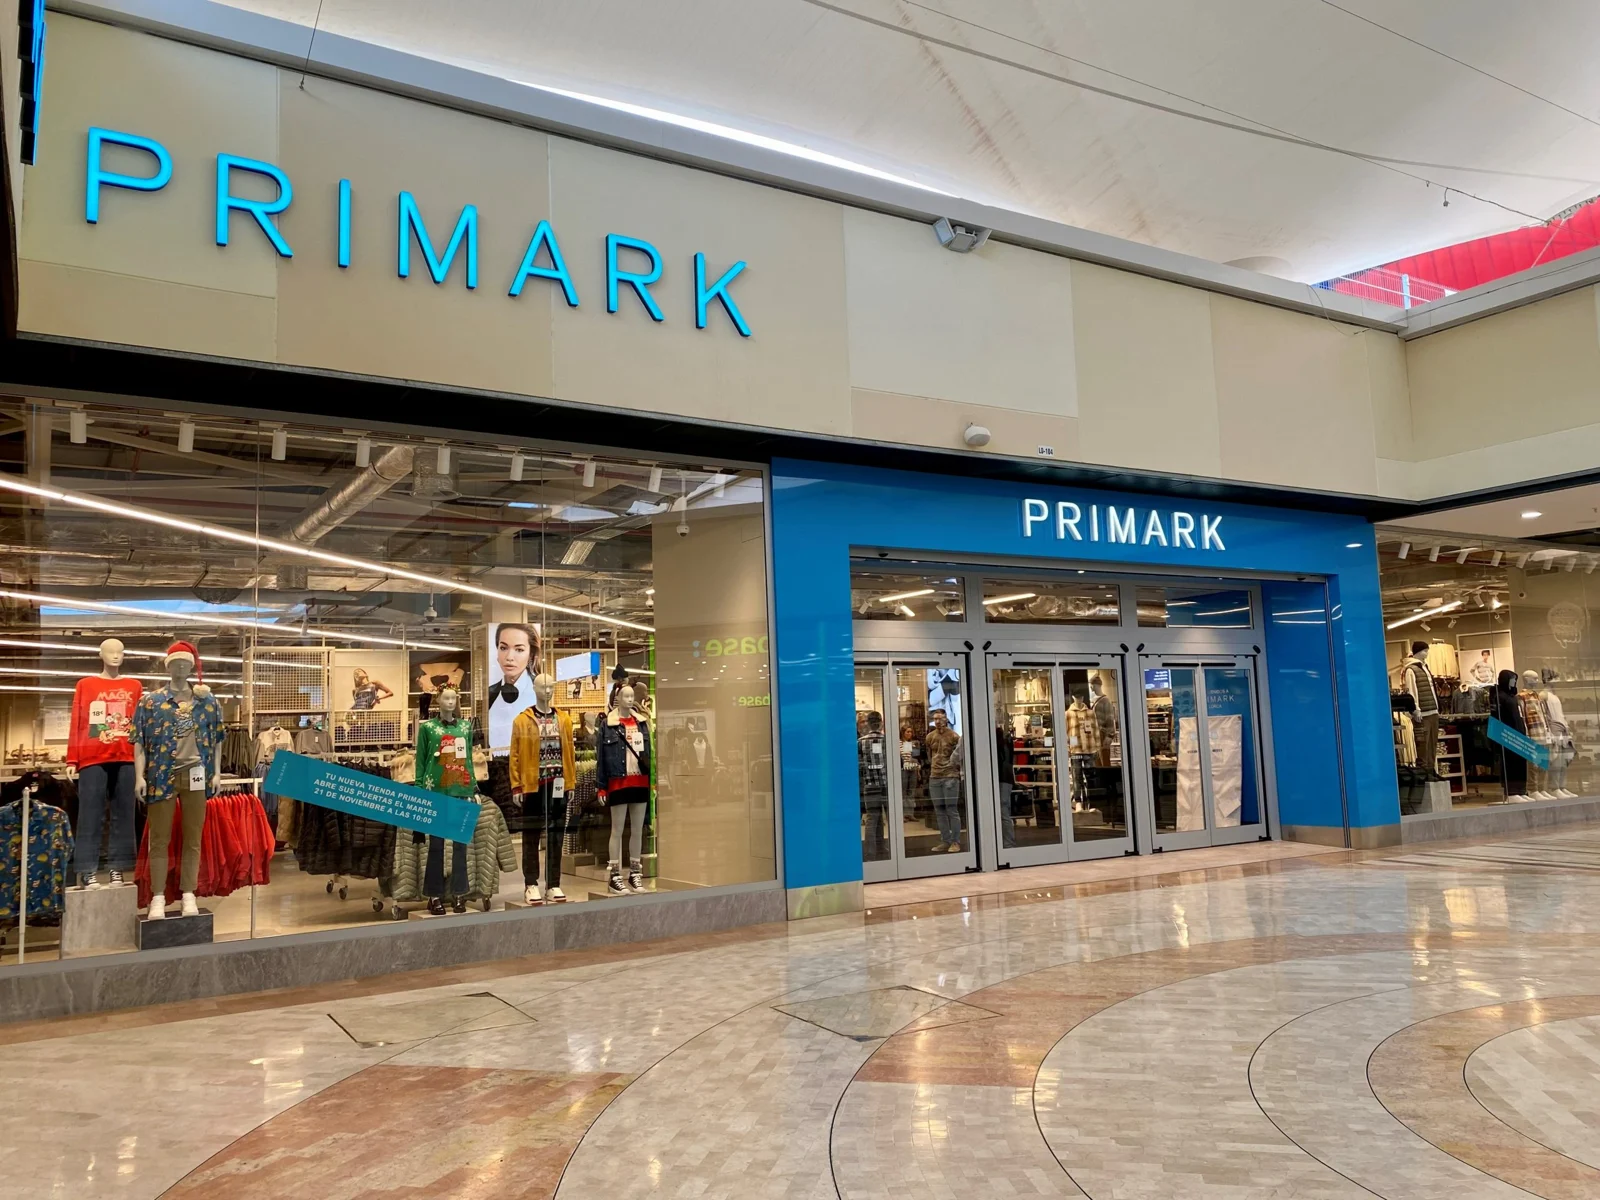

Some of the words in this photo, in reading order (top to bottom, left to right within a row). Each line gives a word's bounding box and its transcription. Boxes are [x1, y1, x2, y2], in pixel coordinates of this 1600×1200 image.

[85, 126, 752, 337] PRIMARK
[1022, 498, 1226, 551] PRIMARK
[97, 691, 133, 701] MAGIC
[1207, 694, 1235, 703] IMARK
[313, 779, 337, 790] ABRE
[338, 785, 355, 795] SUS
[356, 790, 393, 805] PUERTAS
[394, 800, 404, 808] EL
[406, 803, 438, 817] MARTES
[313, 787, 324, 795] 21
[325, 790, 337, 799] DE
[338, 794, 386, 812] NOVIEMBRE
[394, 809, 410, 819] LAS
[412, 814, 433, 824] 10:00
[325, 772, 337, 781] TU
[338, 776, 365, 789] NUEVA
[367, 784, 396, 797] TIENDA
[397, 792, 433, 807] PRIMARK
